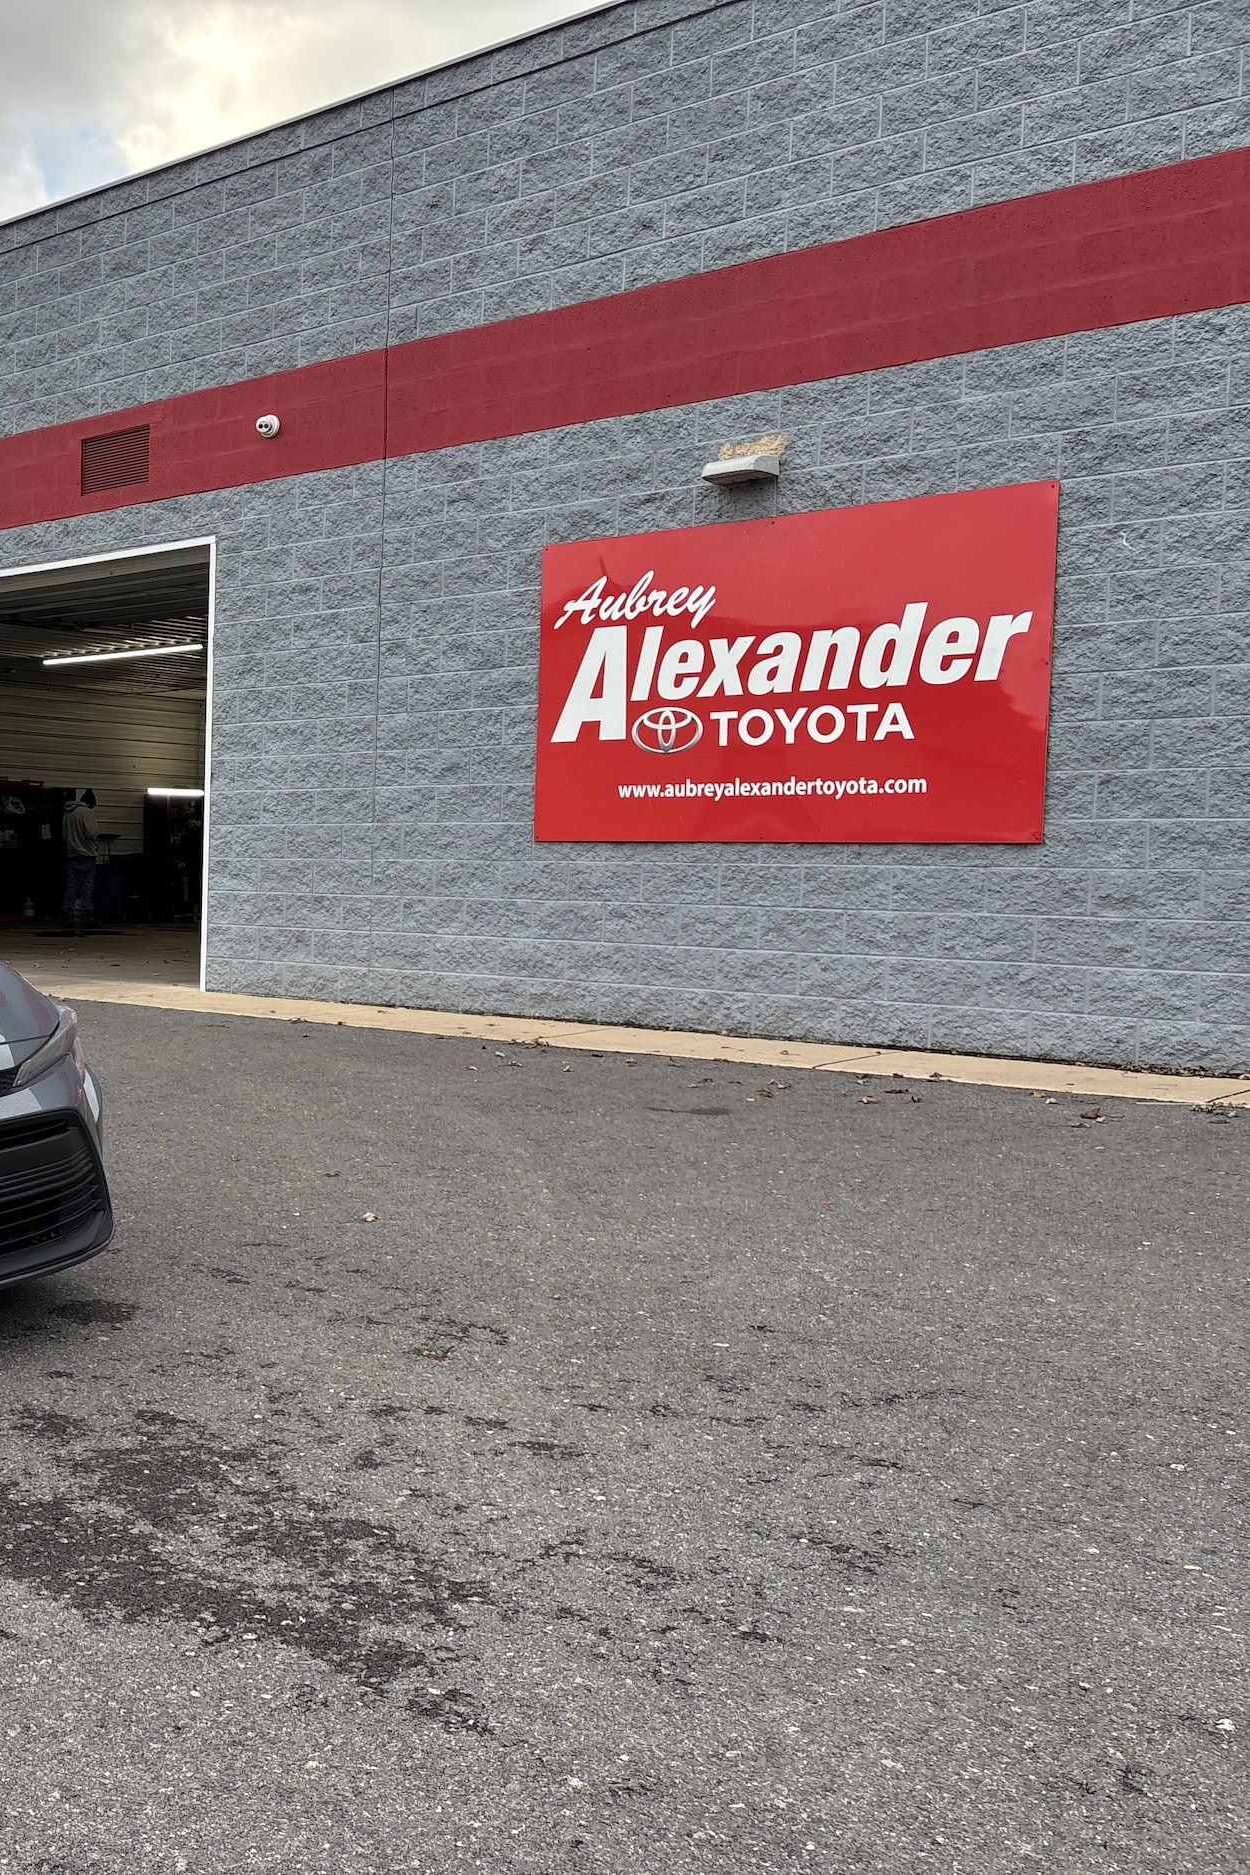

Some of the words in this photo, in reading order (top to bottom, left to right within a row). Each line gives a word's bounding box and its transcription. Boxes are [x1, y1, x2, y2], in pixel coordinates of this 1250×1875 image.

[554, 570, 716, 629] Aubrey
[551, 602, 1033, 743] Alexander
[710, 702, 915, 747] TOYOTA
[617, 776, 927, 802] www.aubreyalexandertoyota.com
